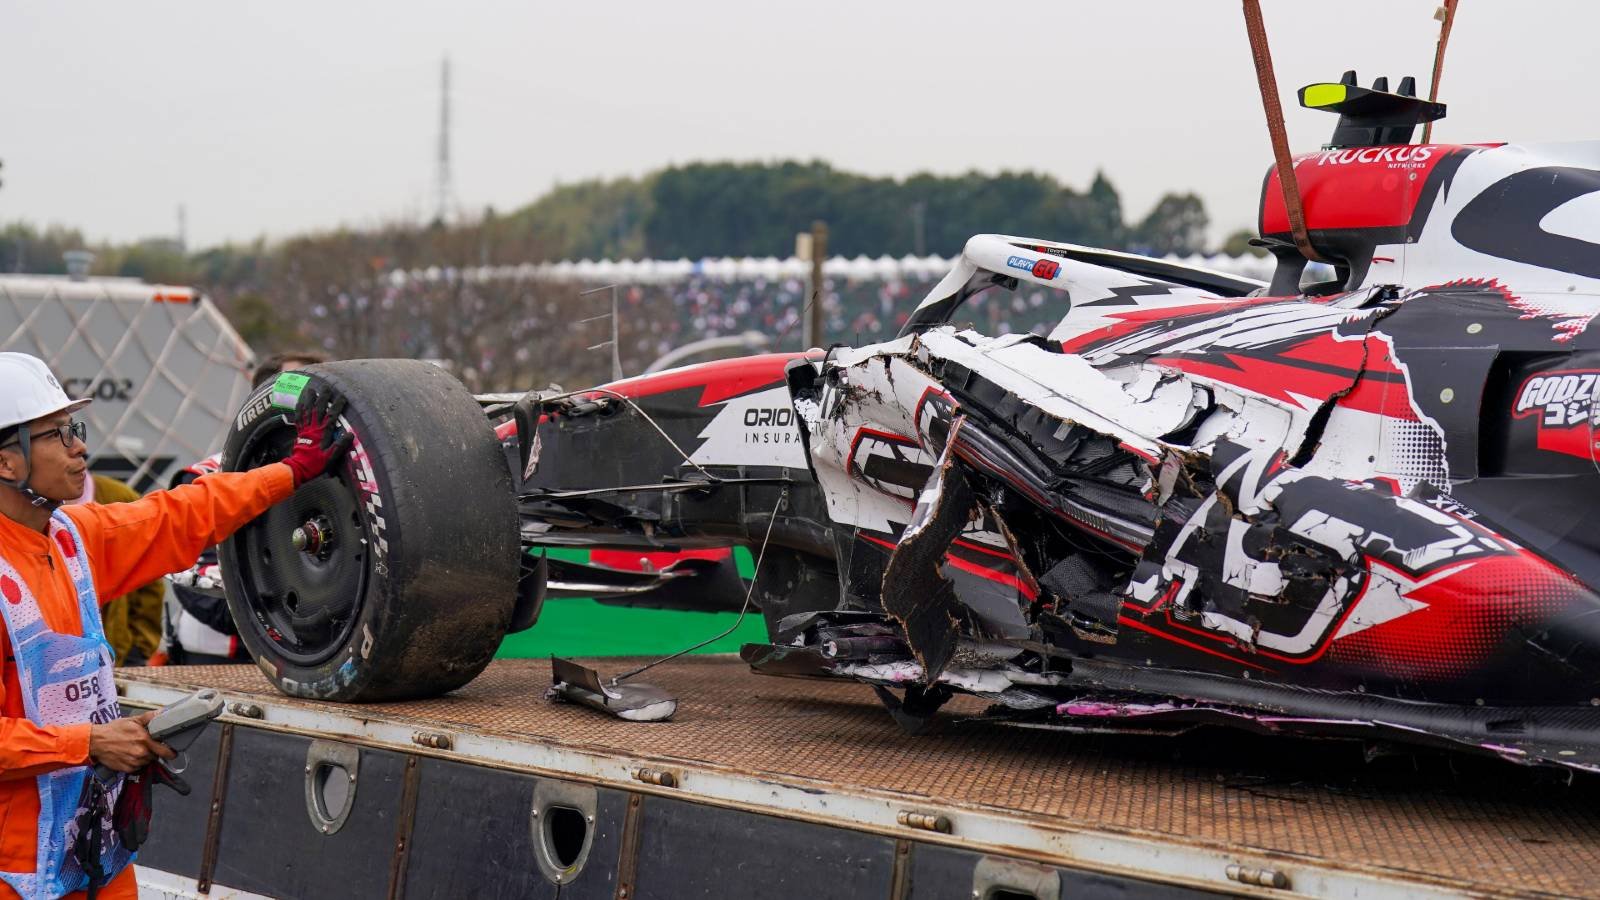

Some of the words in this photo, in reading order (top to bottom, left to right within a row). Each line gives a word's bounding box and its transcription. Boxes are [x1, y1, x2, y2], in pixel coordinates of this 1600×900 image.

[1318, 146, 1438, 166] RUCKUS
[1032, 259, 1060, 280] GO
[65, 676, 100, 702] 058
